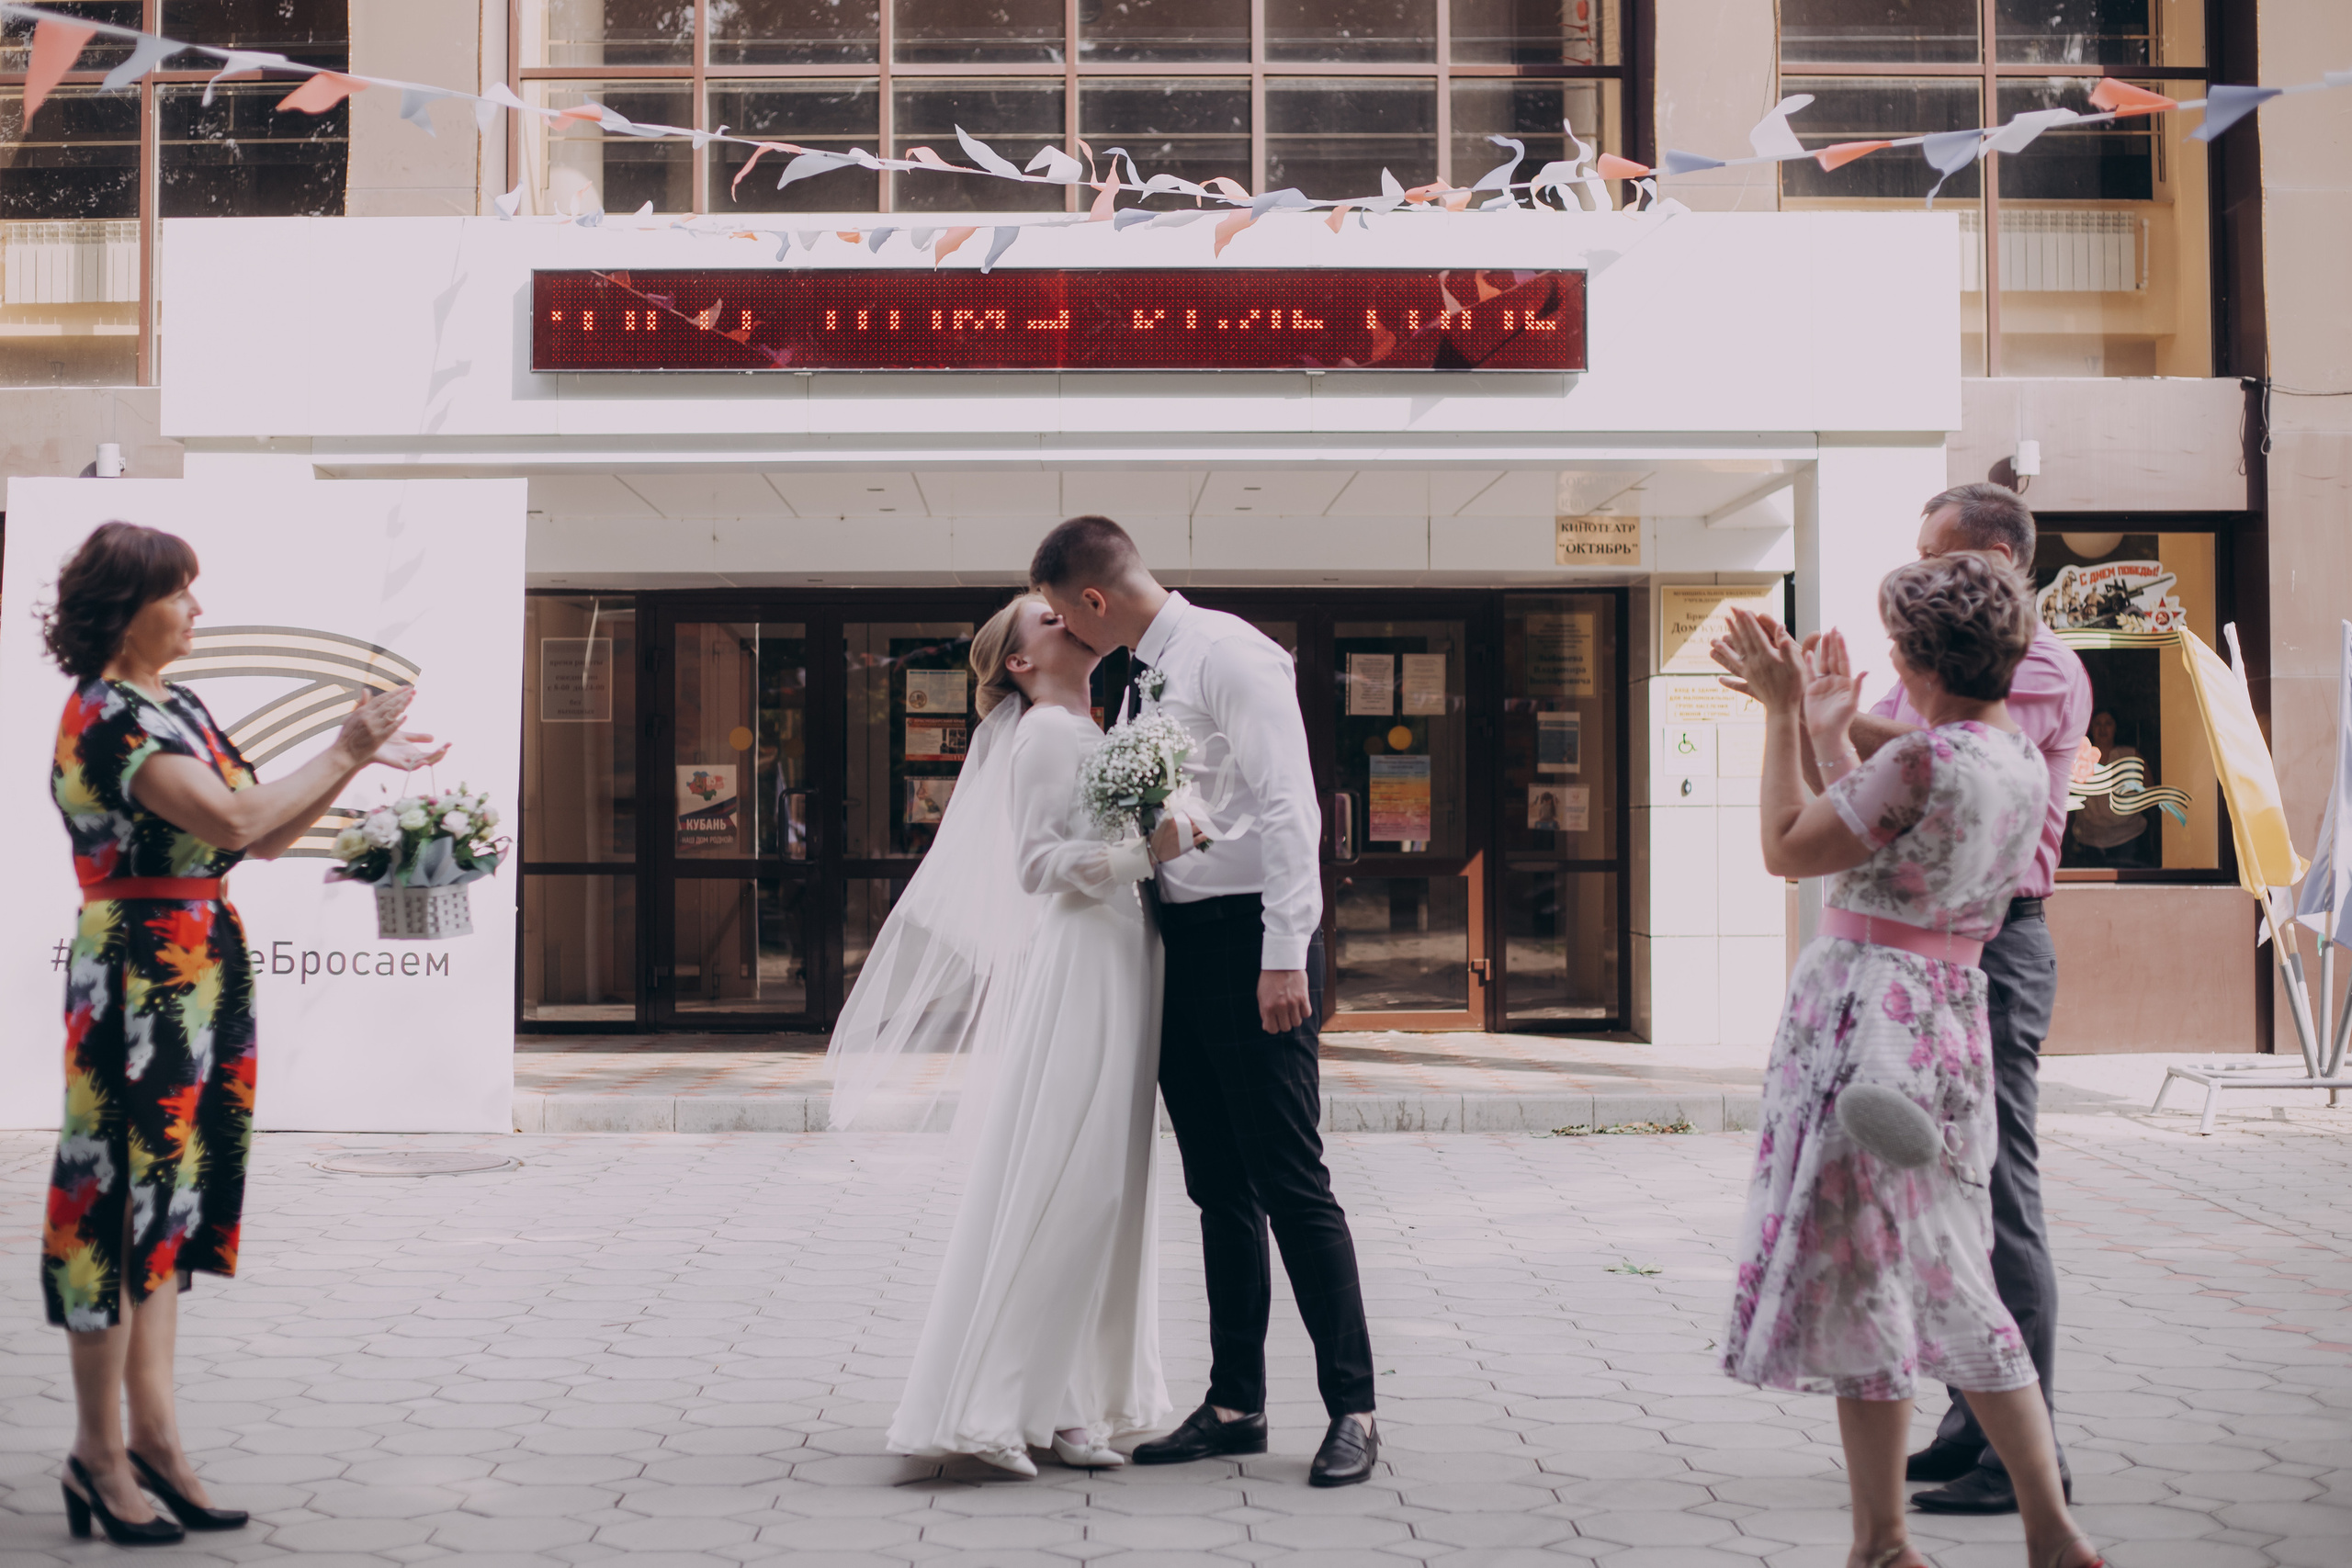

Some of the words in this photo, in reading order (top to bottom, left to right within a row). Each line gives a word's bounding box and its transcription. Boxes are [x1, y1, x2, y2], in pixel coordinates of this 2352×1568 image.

[1561, 523, 1636, 533] КИНОТЕАТР
[2079, 572, 2087, 586] С
[2089, 567, 2116, 585] ДНЕМ
[2118, 565, 2160, 577] ПОБЕДЫ!
[1671, 623, 1697, 635] Дом
[686, 818, 727, 830] КУБАНЬ
